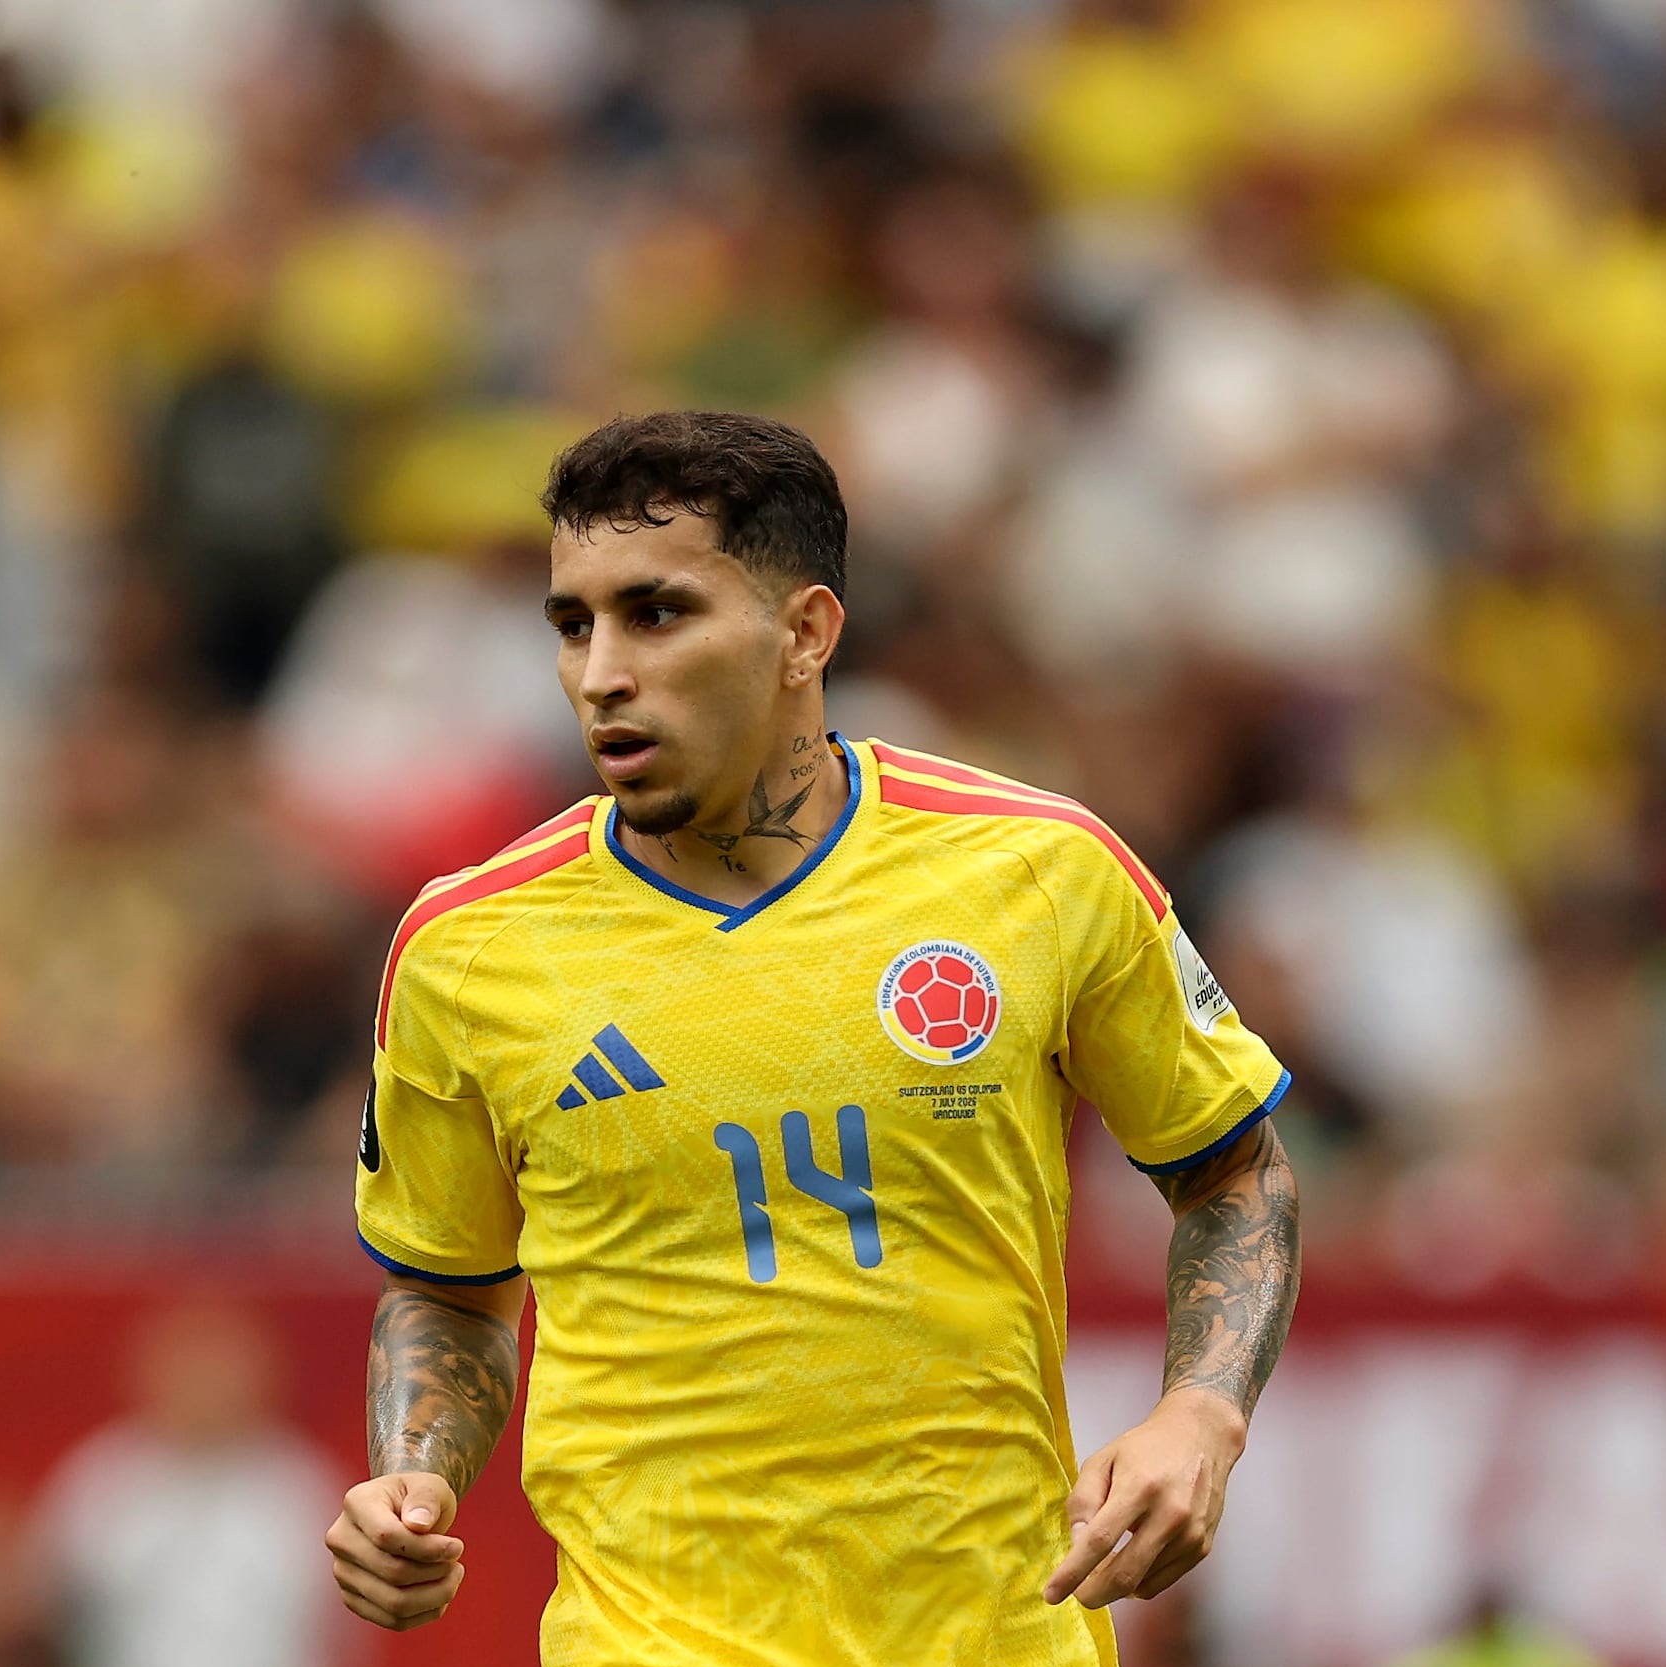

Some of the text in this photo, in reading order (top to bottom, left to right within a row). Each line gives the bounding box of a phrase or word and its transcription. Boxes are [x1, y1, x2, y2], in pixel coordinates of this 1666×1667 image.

[905, 944, 963, 962] COLOMBIANA
[963, 952, 976, 964] DE
[899, 1084, 1002, 1097] SWITZERLAND VS COLOMBIA
[938, 1097, 956, 1108] JULY
[957, 1097, 978, 1107] 2026
[932, 1109, 976, 1119] VANCOUVER
[713, 1104, 883, 1284] 14
